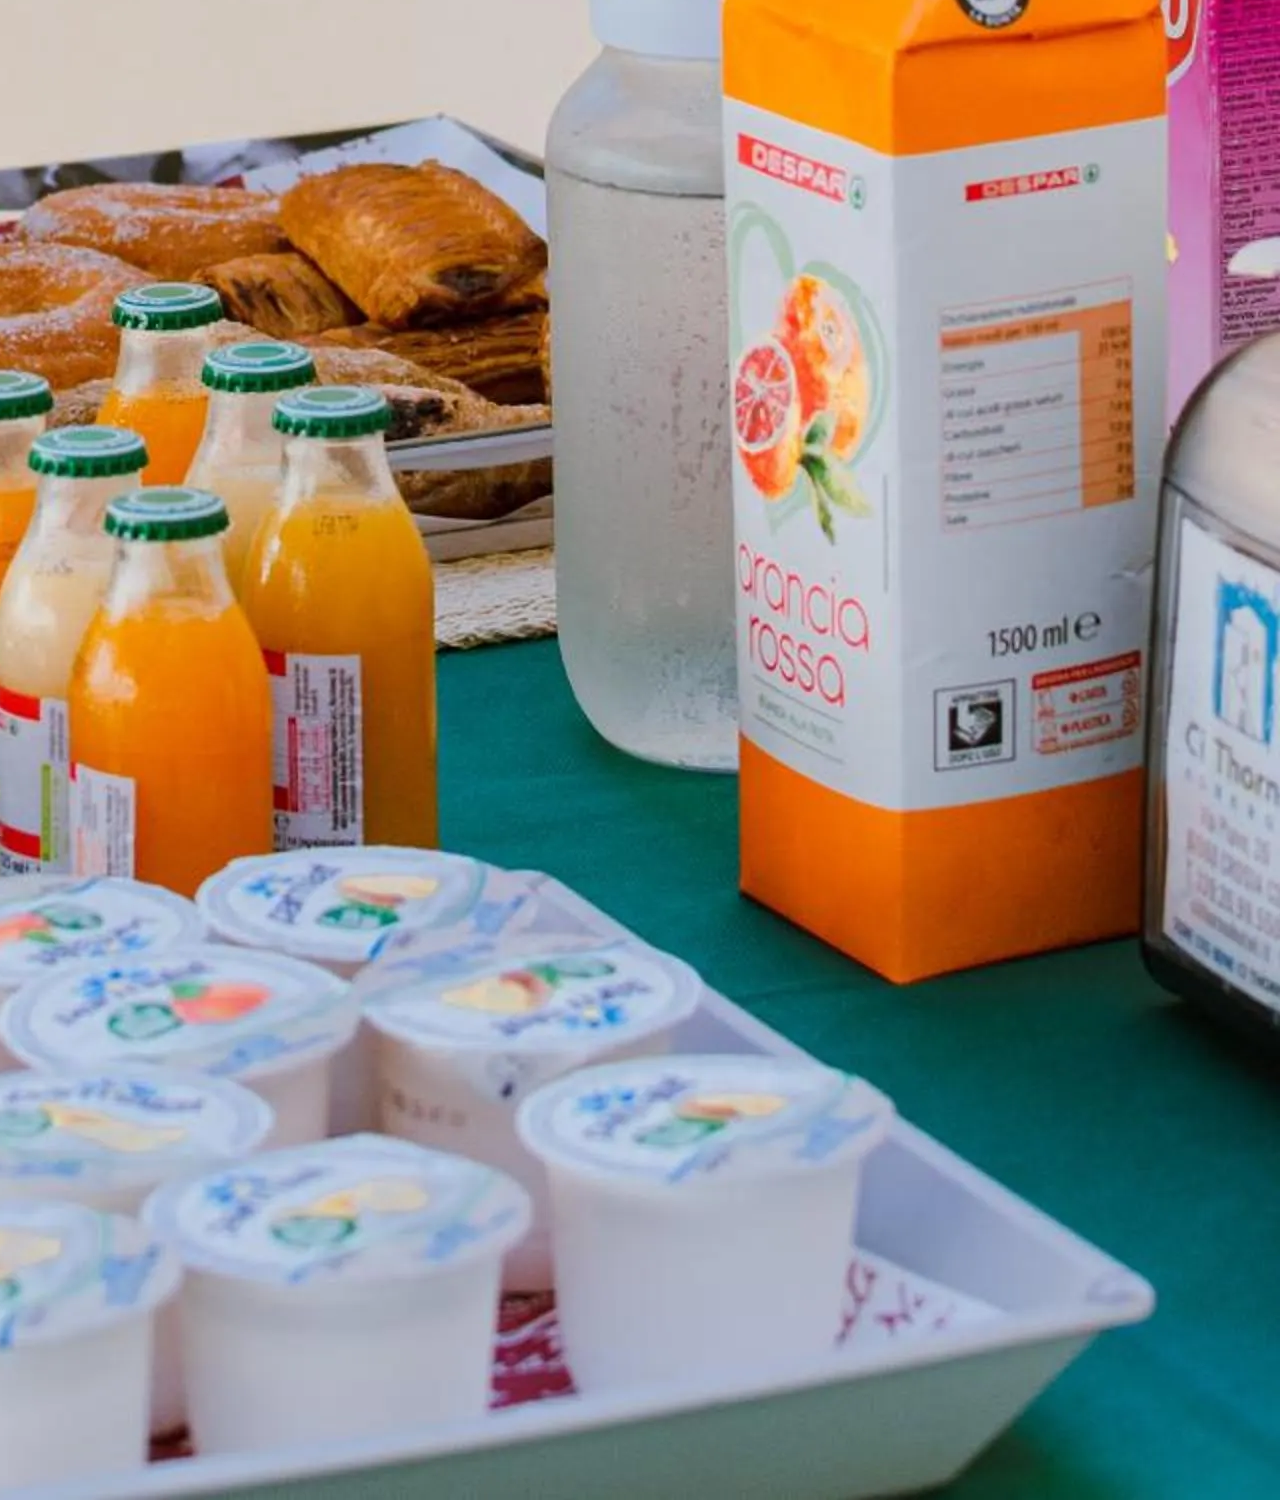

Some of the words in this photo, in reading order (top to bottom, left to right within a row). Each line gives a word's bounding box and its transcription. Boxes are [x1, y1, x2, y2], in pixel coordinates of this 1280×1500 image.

[751, 142, 845, 198] DESPAR
[982, 168, 1079, 198] DESPAR
[738, 541, 870, 653] arancia
[748, 613, 845, 708] rossa
[987, 623, 1038, 658] 1500
[1042, 613, 1069, 649] ml
